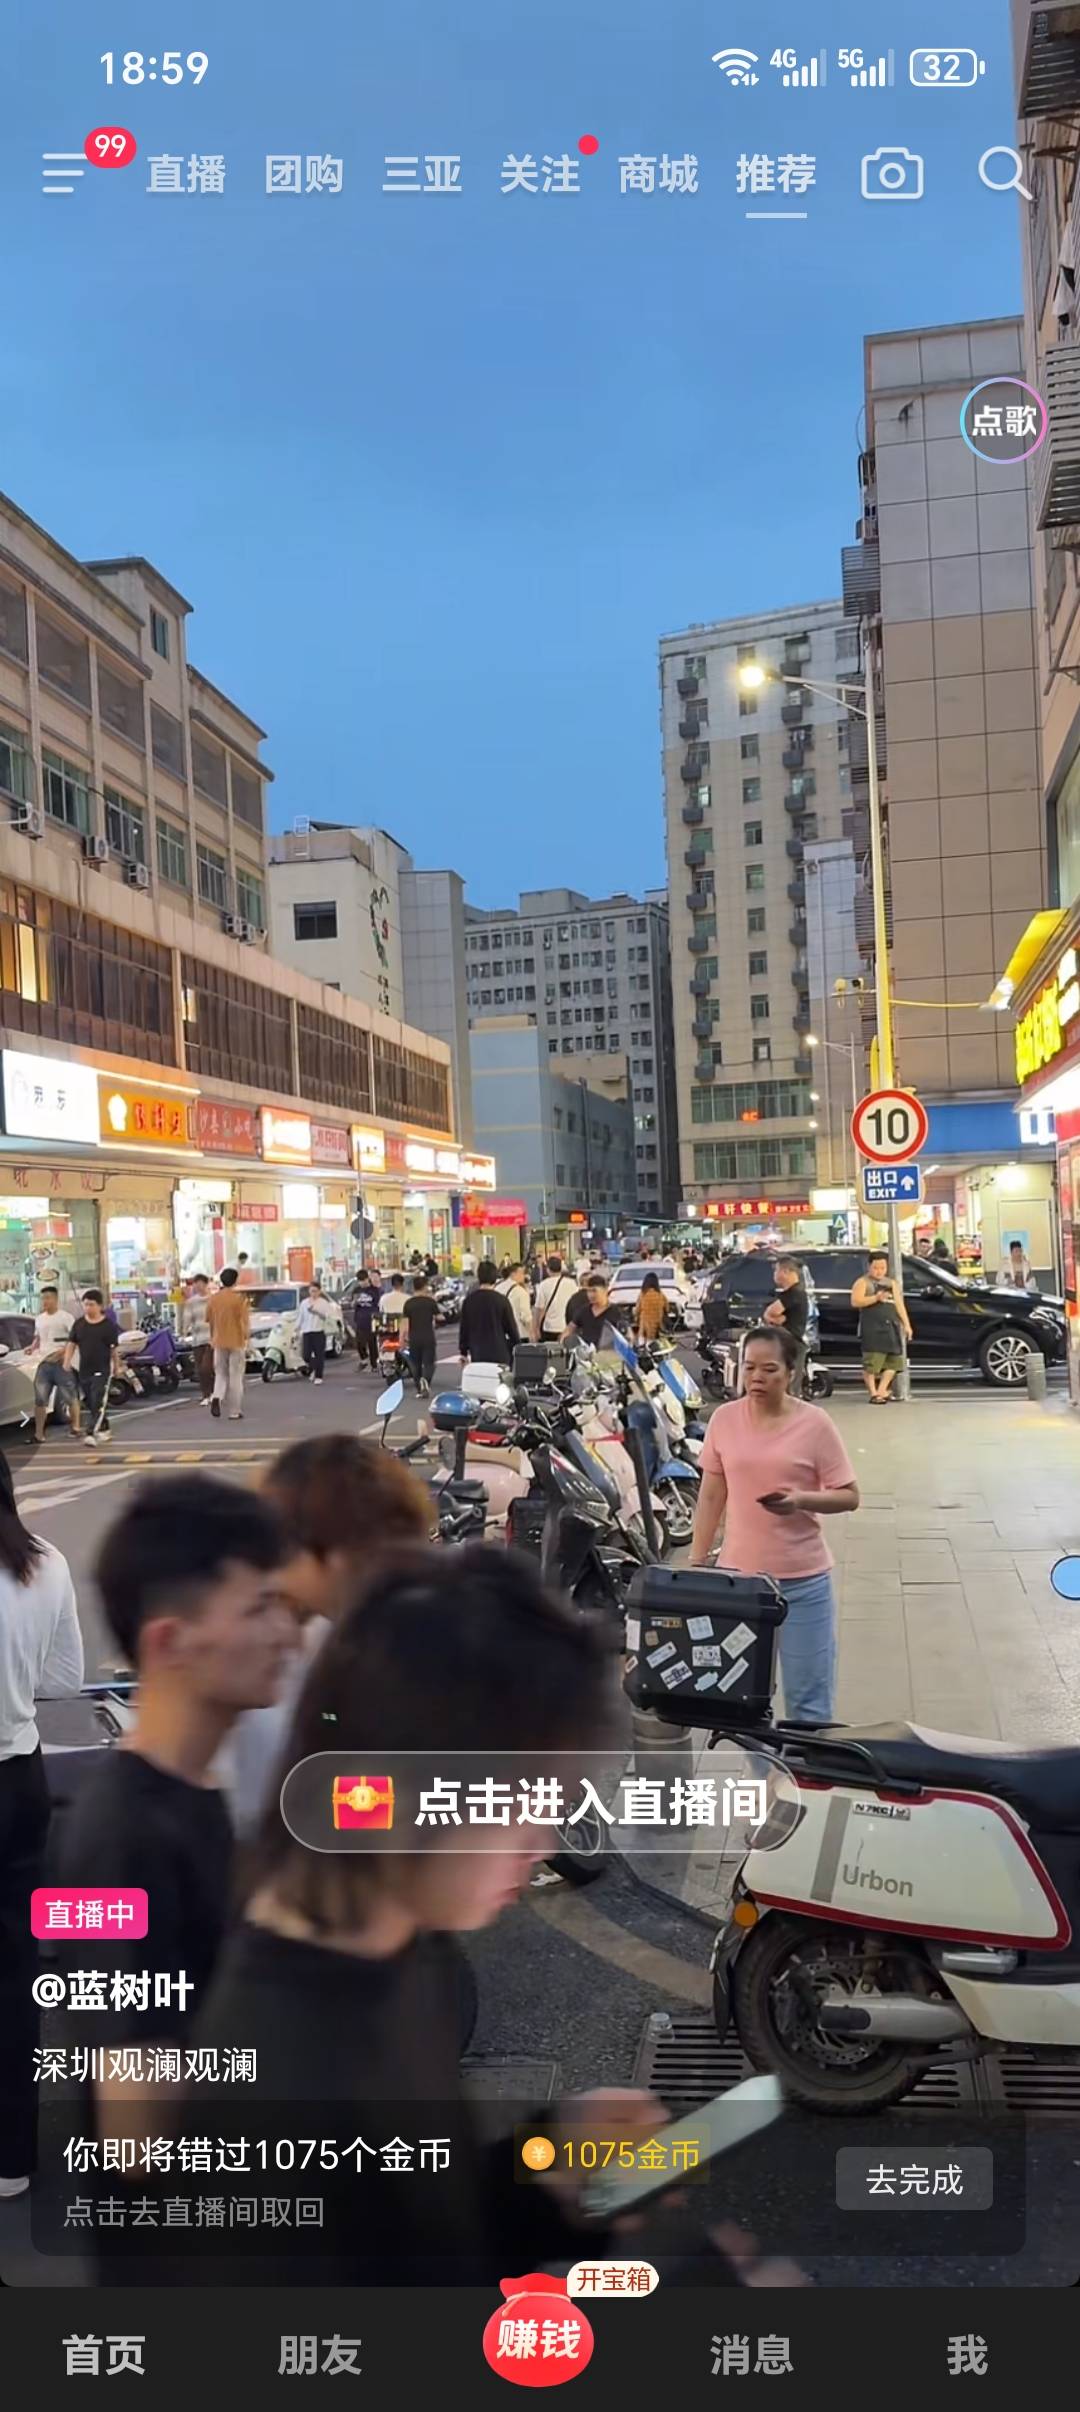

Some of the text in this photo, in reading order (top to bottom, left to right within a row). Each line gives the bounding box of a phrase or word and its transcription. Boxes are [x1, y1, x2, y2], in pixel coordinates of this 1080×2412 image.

[867, 1108, 909, 1146] 10
[867, 1170, 898, 1187] 出口
[868, 1187, 898, 1199] EXIT
[843, 1864, 914, 1898] Urbon
